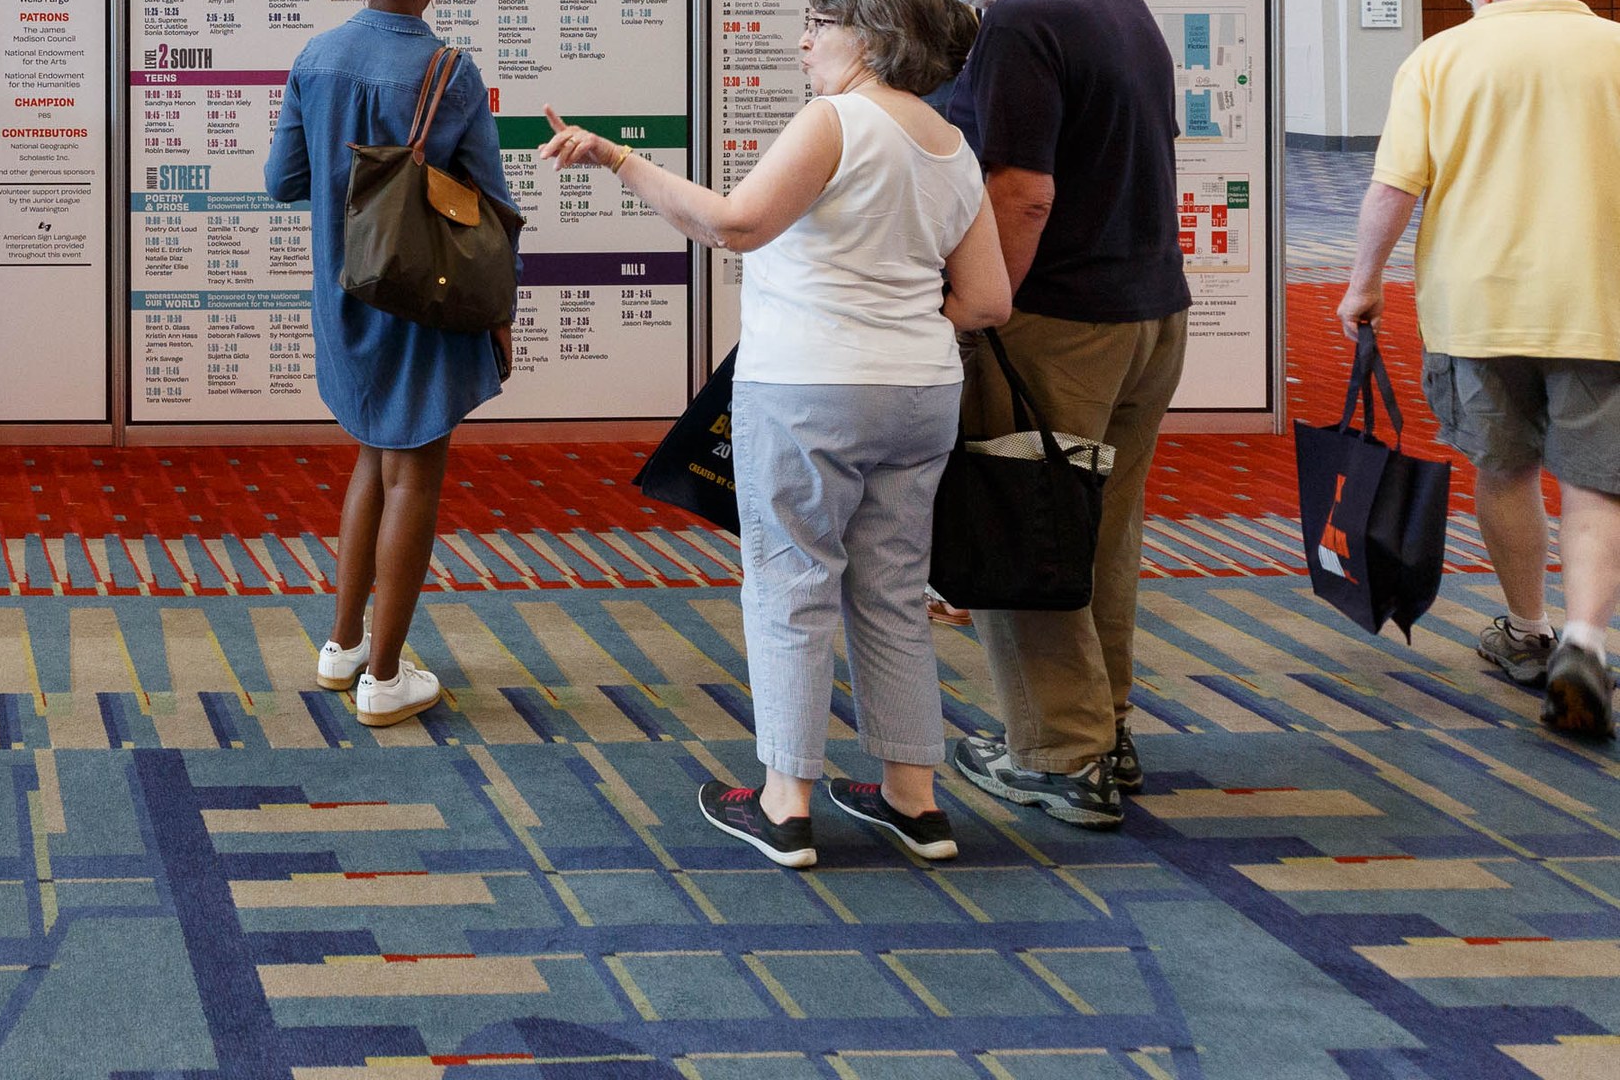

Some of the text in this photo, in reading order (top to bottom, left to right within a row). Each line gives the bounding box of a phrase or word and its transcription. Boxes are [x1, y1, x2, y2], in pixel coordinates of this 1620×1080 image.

[20, 13, 69, 21] PATRONS
[144, 43, 212, 69] LEVEL 2 SOUTH
[145, 74, 176, 82] TEENS
[15, 98, 74, 106] CHAMPION
[2, 129, 87, 137] CONTRIBUTORS
[622, 127, 645, 138] HALL A
[146, 165, 211, 190] NORTH STREET
[146, 194, 184, 202] POETRY
[145, 203, 189, 211] & PROSE
[622, 264, 645, 275] HALL B
[165, 299, 201, 308] WORLD
[712, 441, 731, 459] 20
[688, 462, 727, 486] CREATED BY
